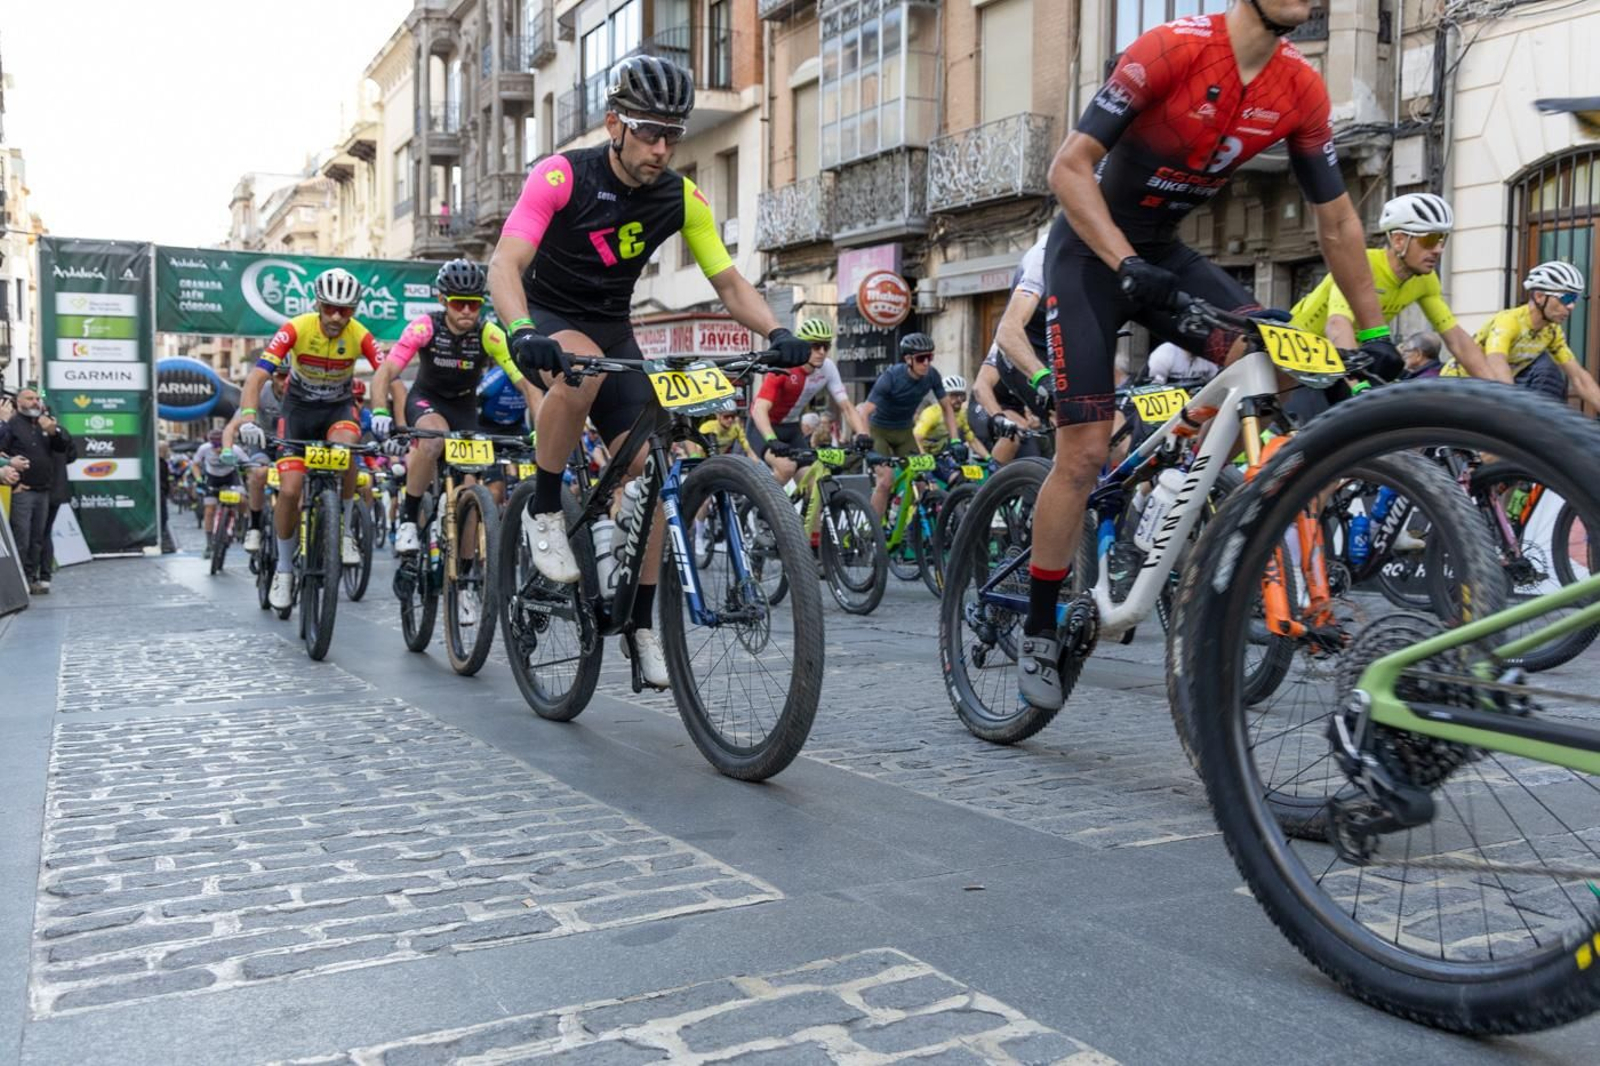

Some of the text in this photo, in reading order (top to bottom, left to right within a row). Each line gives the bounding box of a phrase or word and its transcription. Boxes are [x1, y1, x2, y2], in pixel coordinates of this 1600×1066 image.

[1146, 176, 1189, 192] BIKE
[178, 279, 223, 290] GRANADA
[179, 300, 223, 312] CÓRDOBA
[700, 333, 749, 346] JAVIER
[1268, 329, 1336, 365] 219-2
[1051, 323, 1069, 391] ESPEJO
[64, 370, 132, 381] GARMIN
[158, 382, 212, 394] ARMIN
[657, 371, 728, 401] 201-2
[310, 448, 348, 466] 231-2
[450, 441, 490, 459] 201-1
